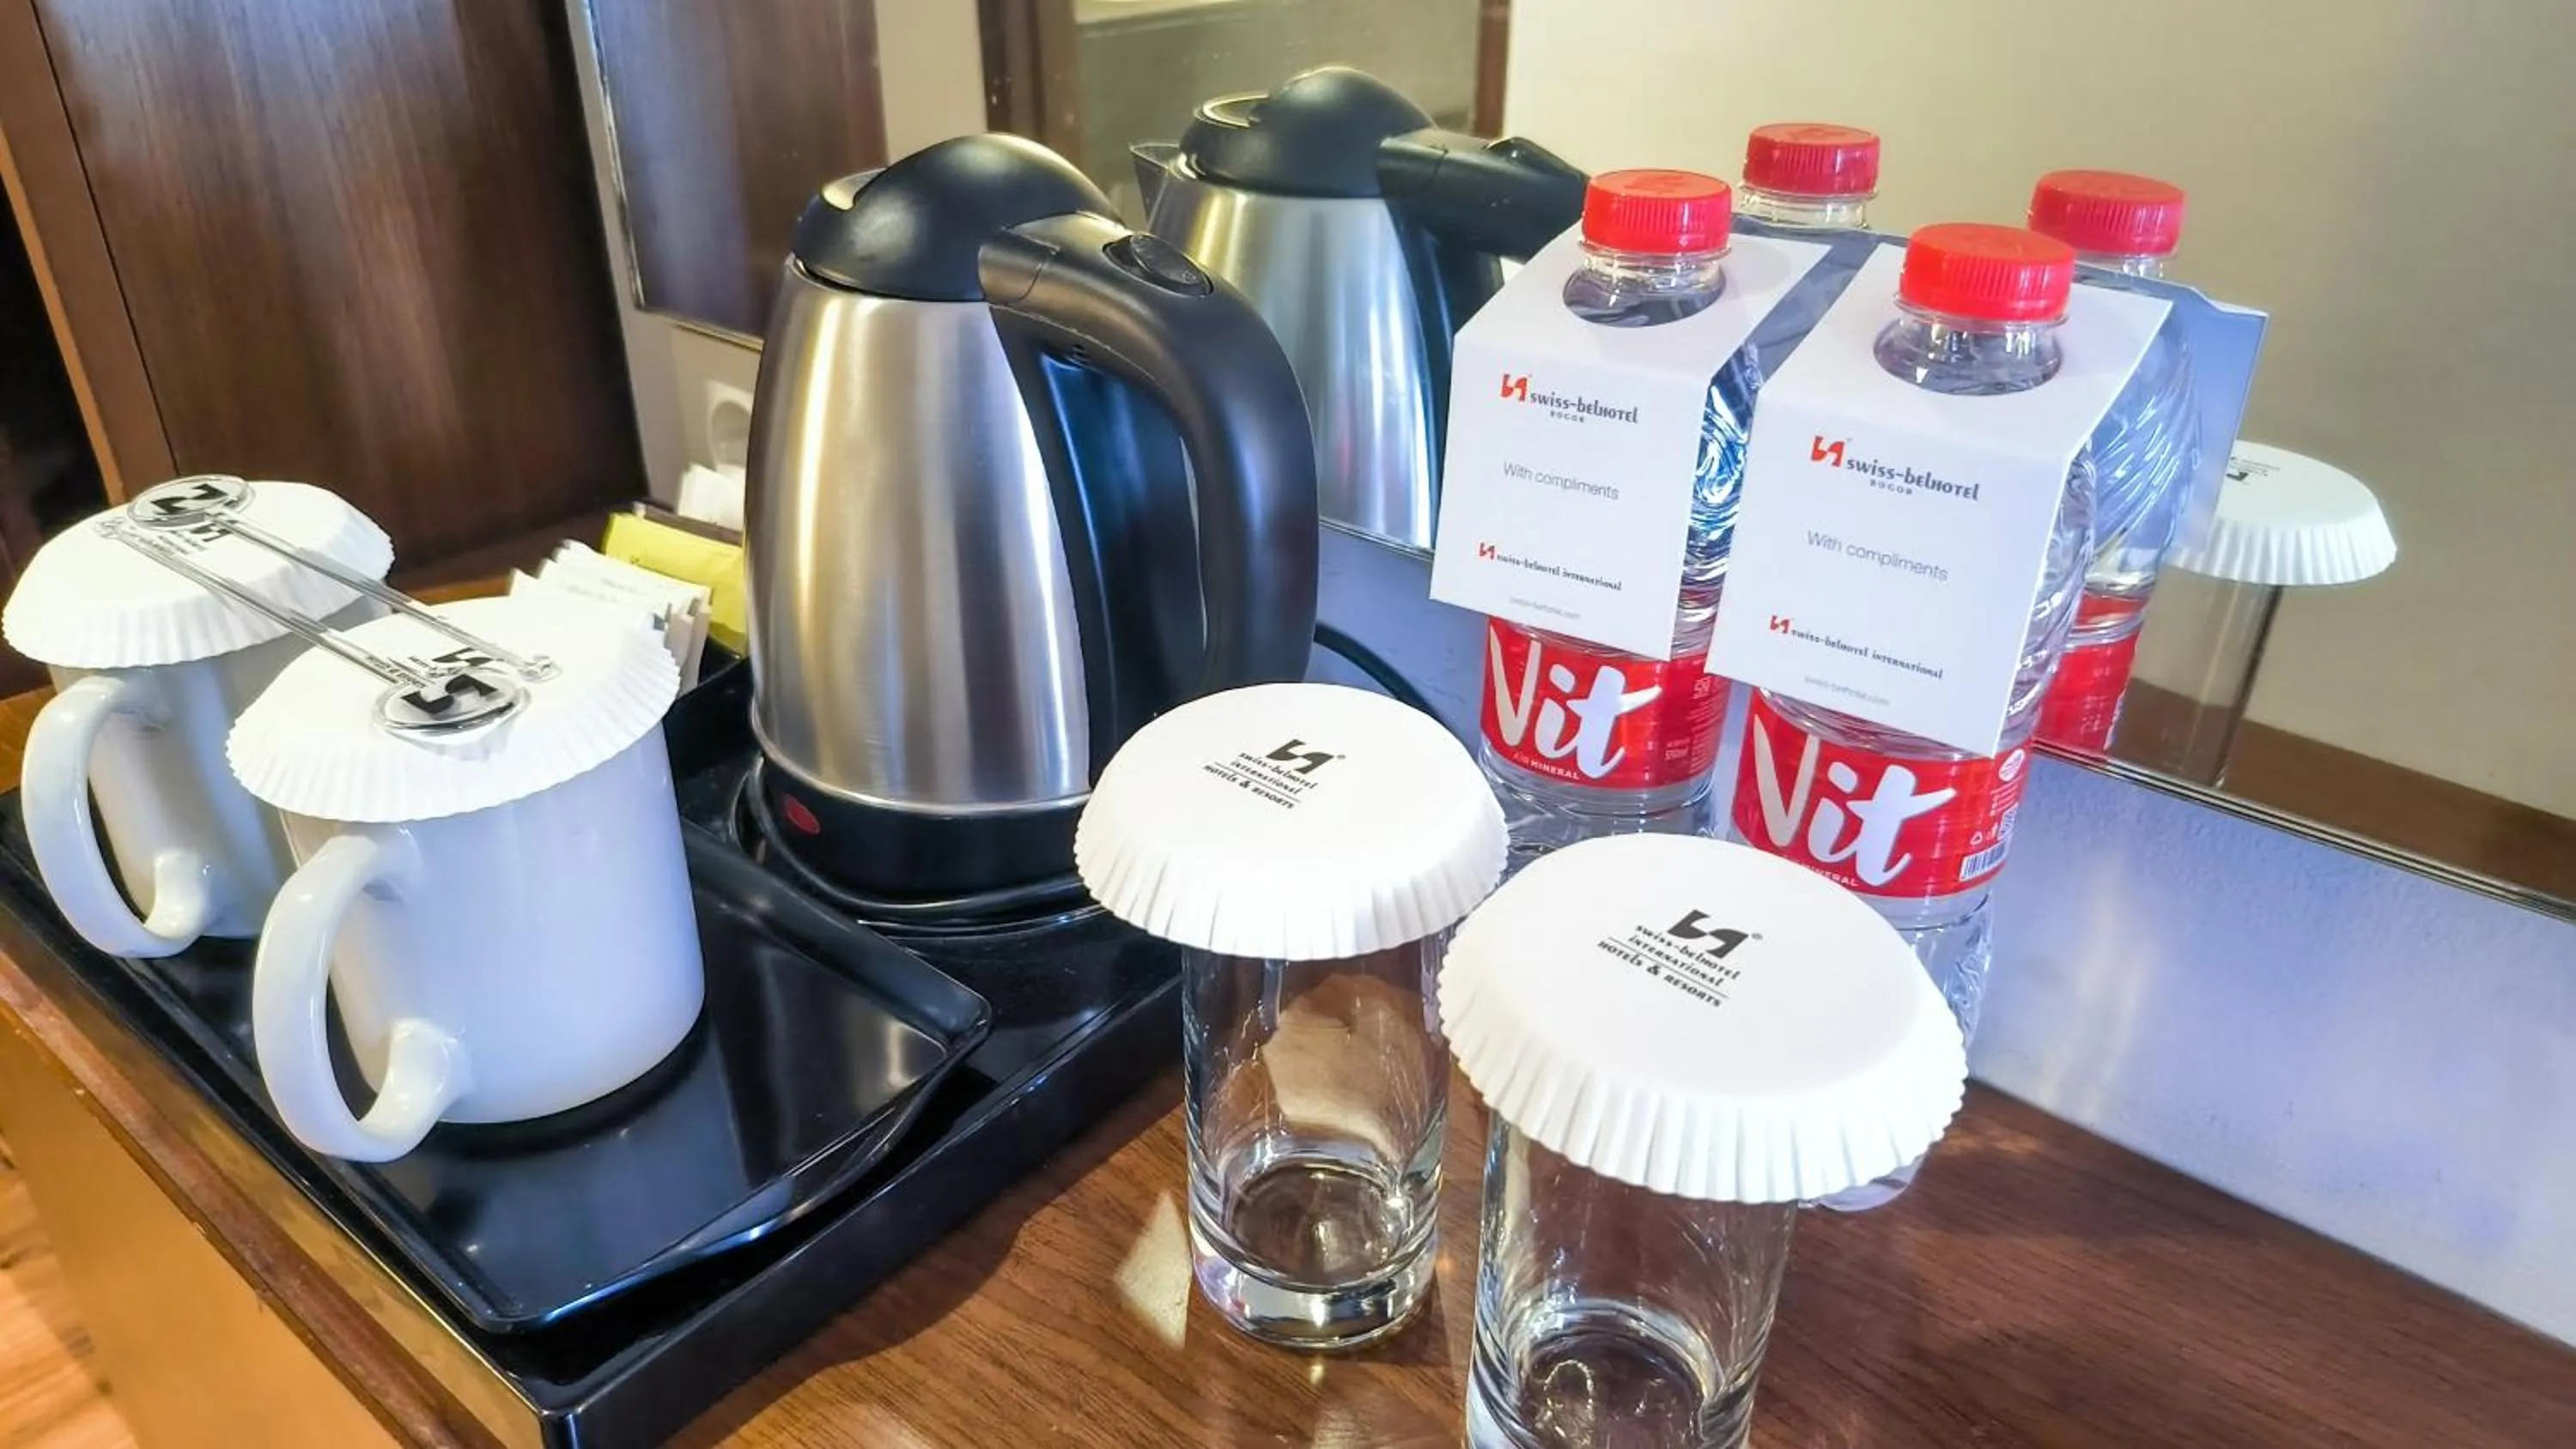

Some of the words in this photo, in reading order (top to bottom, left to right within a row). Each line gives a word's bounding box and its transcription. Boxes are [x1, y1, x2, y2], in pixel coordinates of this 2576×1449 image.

[1504, 462, 1534, 480] With
[1535, 471, 1619, 500] compliments
[1807, 530, 1843, 553] With
[1846, 543, 1948, 582] compliments
[1489, 624, 1663, 779] Vit
[1238, 779, 1251, 789] &
[1753, 713, 1957, 887] Vit
[1646, 964, 1661, 977] &
